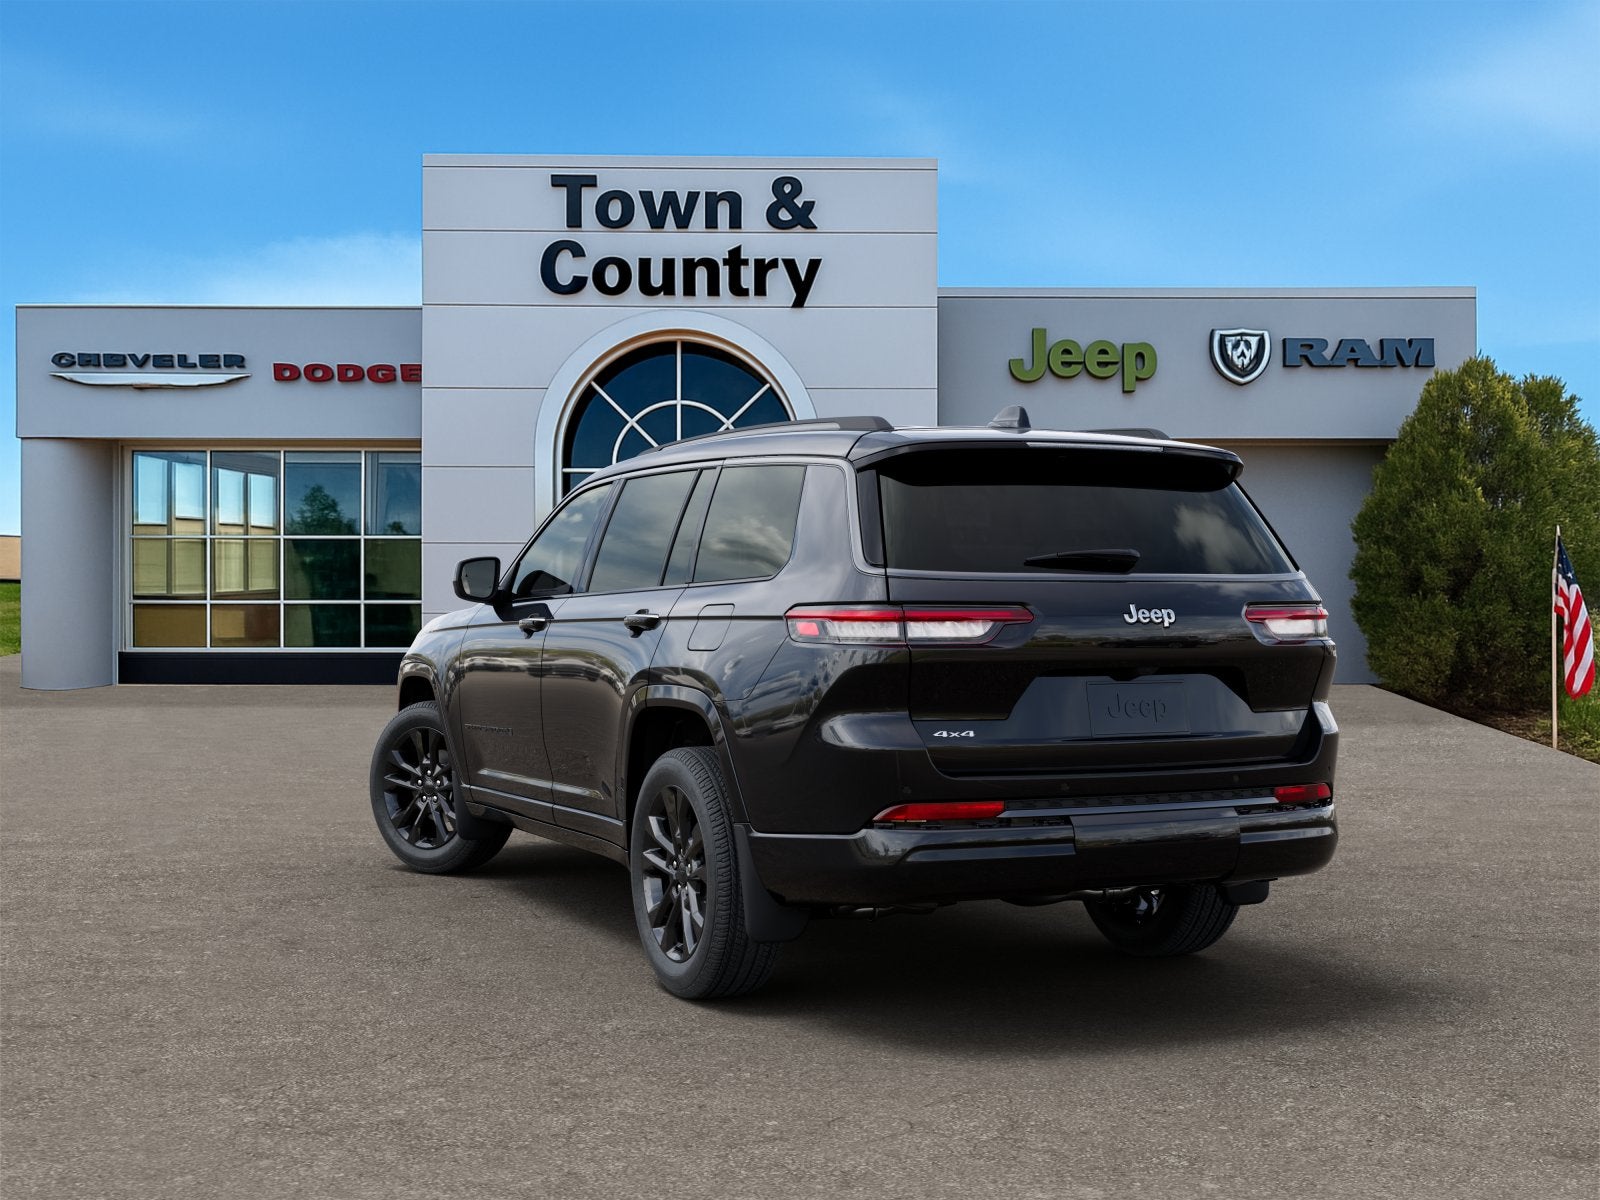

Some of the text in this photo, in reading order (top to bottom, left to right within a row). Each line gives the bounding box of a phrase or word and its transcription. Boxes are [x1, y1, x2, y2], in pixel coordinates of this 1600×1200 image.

[551, 174, 818, 230] Town &
[540, 239, 822, 308] Country
[1009, 327, 1158, 393] Jeep
[1282, 337, 1436, 368] RAM
[273, 363, 422, 383] DODGE
[1123, 603, 1176, 628] Jeep
[1106, 688, 1167, 725] Jeep
